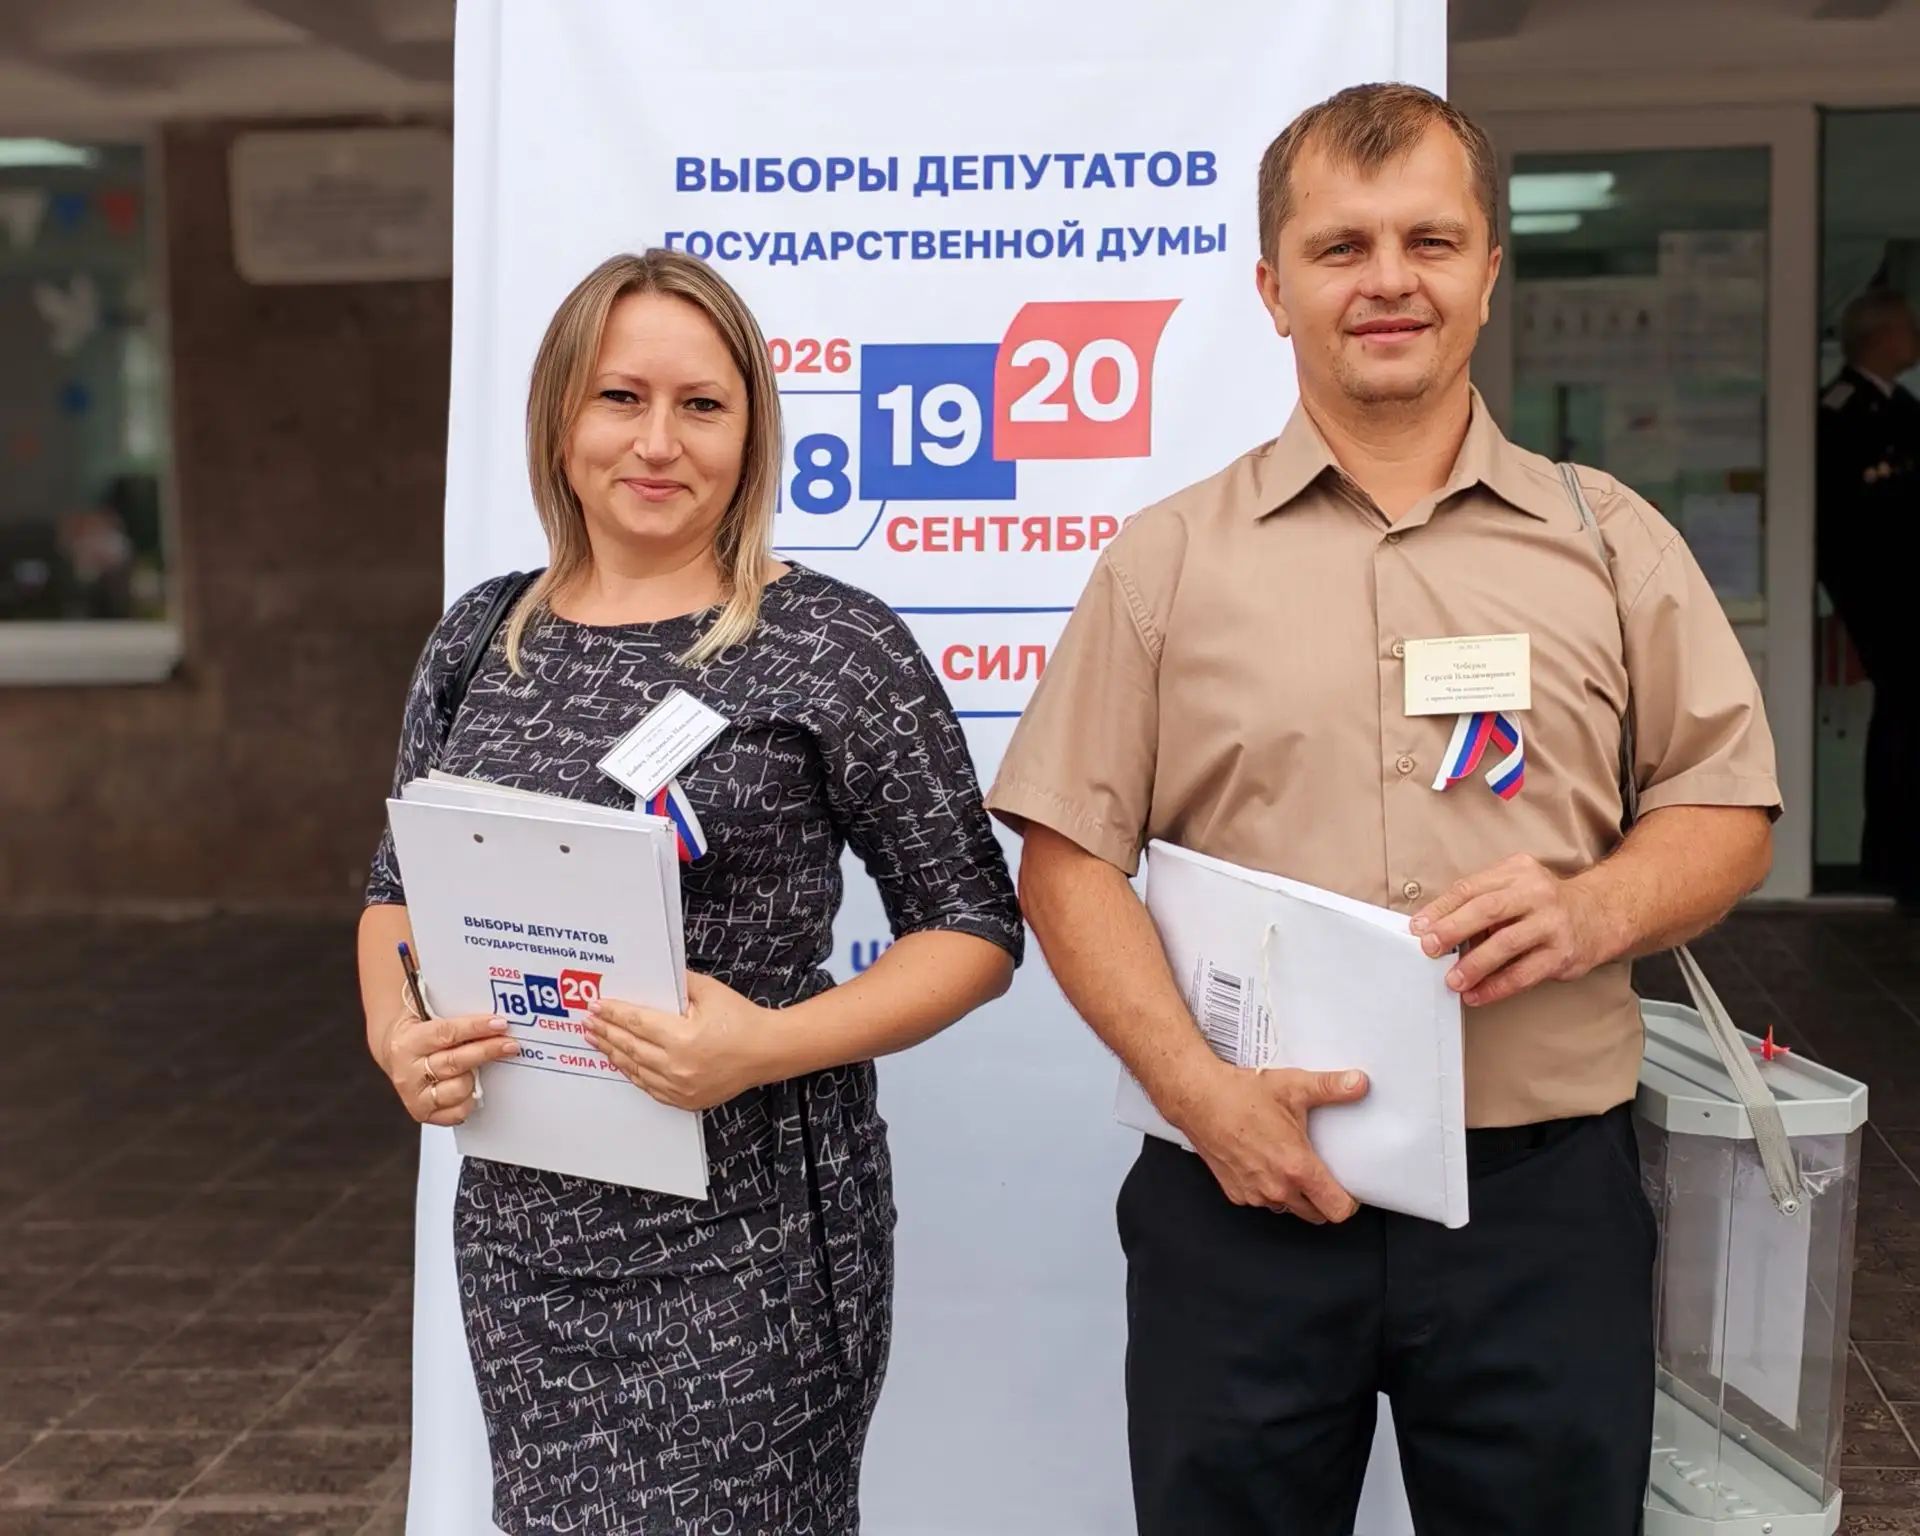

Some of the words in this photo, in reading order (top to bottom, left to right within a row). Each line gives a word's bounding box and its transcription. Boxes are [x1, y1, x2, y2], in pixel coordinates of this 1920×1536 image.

[676, 156, 899, 192] ВЫБОРЫ
[913, 151, 1218, 197] ДЕПУТАТОВ
[665, 221, 1083, 265] ГОСУДАРСТВЕННОЙ
[1097, 223, 1227, 262] ДУМЫ
[1009, 339, 1139, 422] 20
[878, 383, 983, 466] 19
[776, 433, 852, 514] 8
[464, 916, 524, 934] ВЫБОРЫ
[528, 924, 608, 945] ДЕПУТАТОВ
[464, 935, 577, 959] ГОСУДАРСТВЕННОЙ
[579, 951, 615, 963] ДУМЫ
[489, 967, 521, 979] 2026
[498, 992, 528, 1016] 18
[529, 984, 560, 1009] 19
[562, 978, 598, 1002] 20
[559, 1054, 597, 1070] СИЛА
